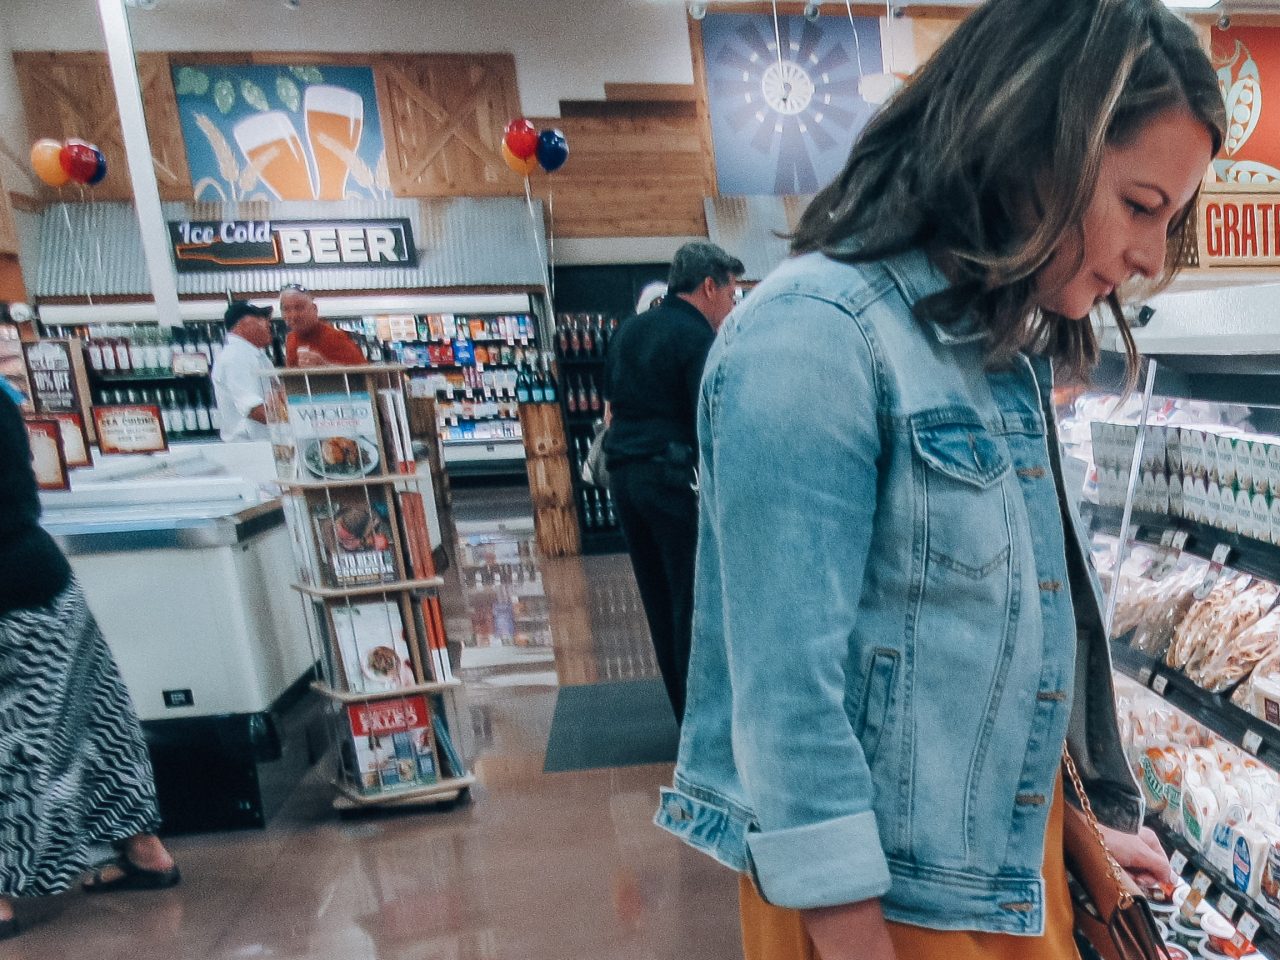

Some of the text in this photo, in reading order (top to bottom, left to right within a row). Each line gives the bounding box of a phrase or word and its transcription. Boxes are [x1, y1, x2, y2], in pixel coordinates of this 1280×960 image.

[179, 220, 271, 244] Ice Cold
[280, 228, 400, 264] BEER
